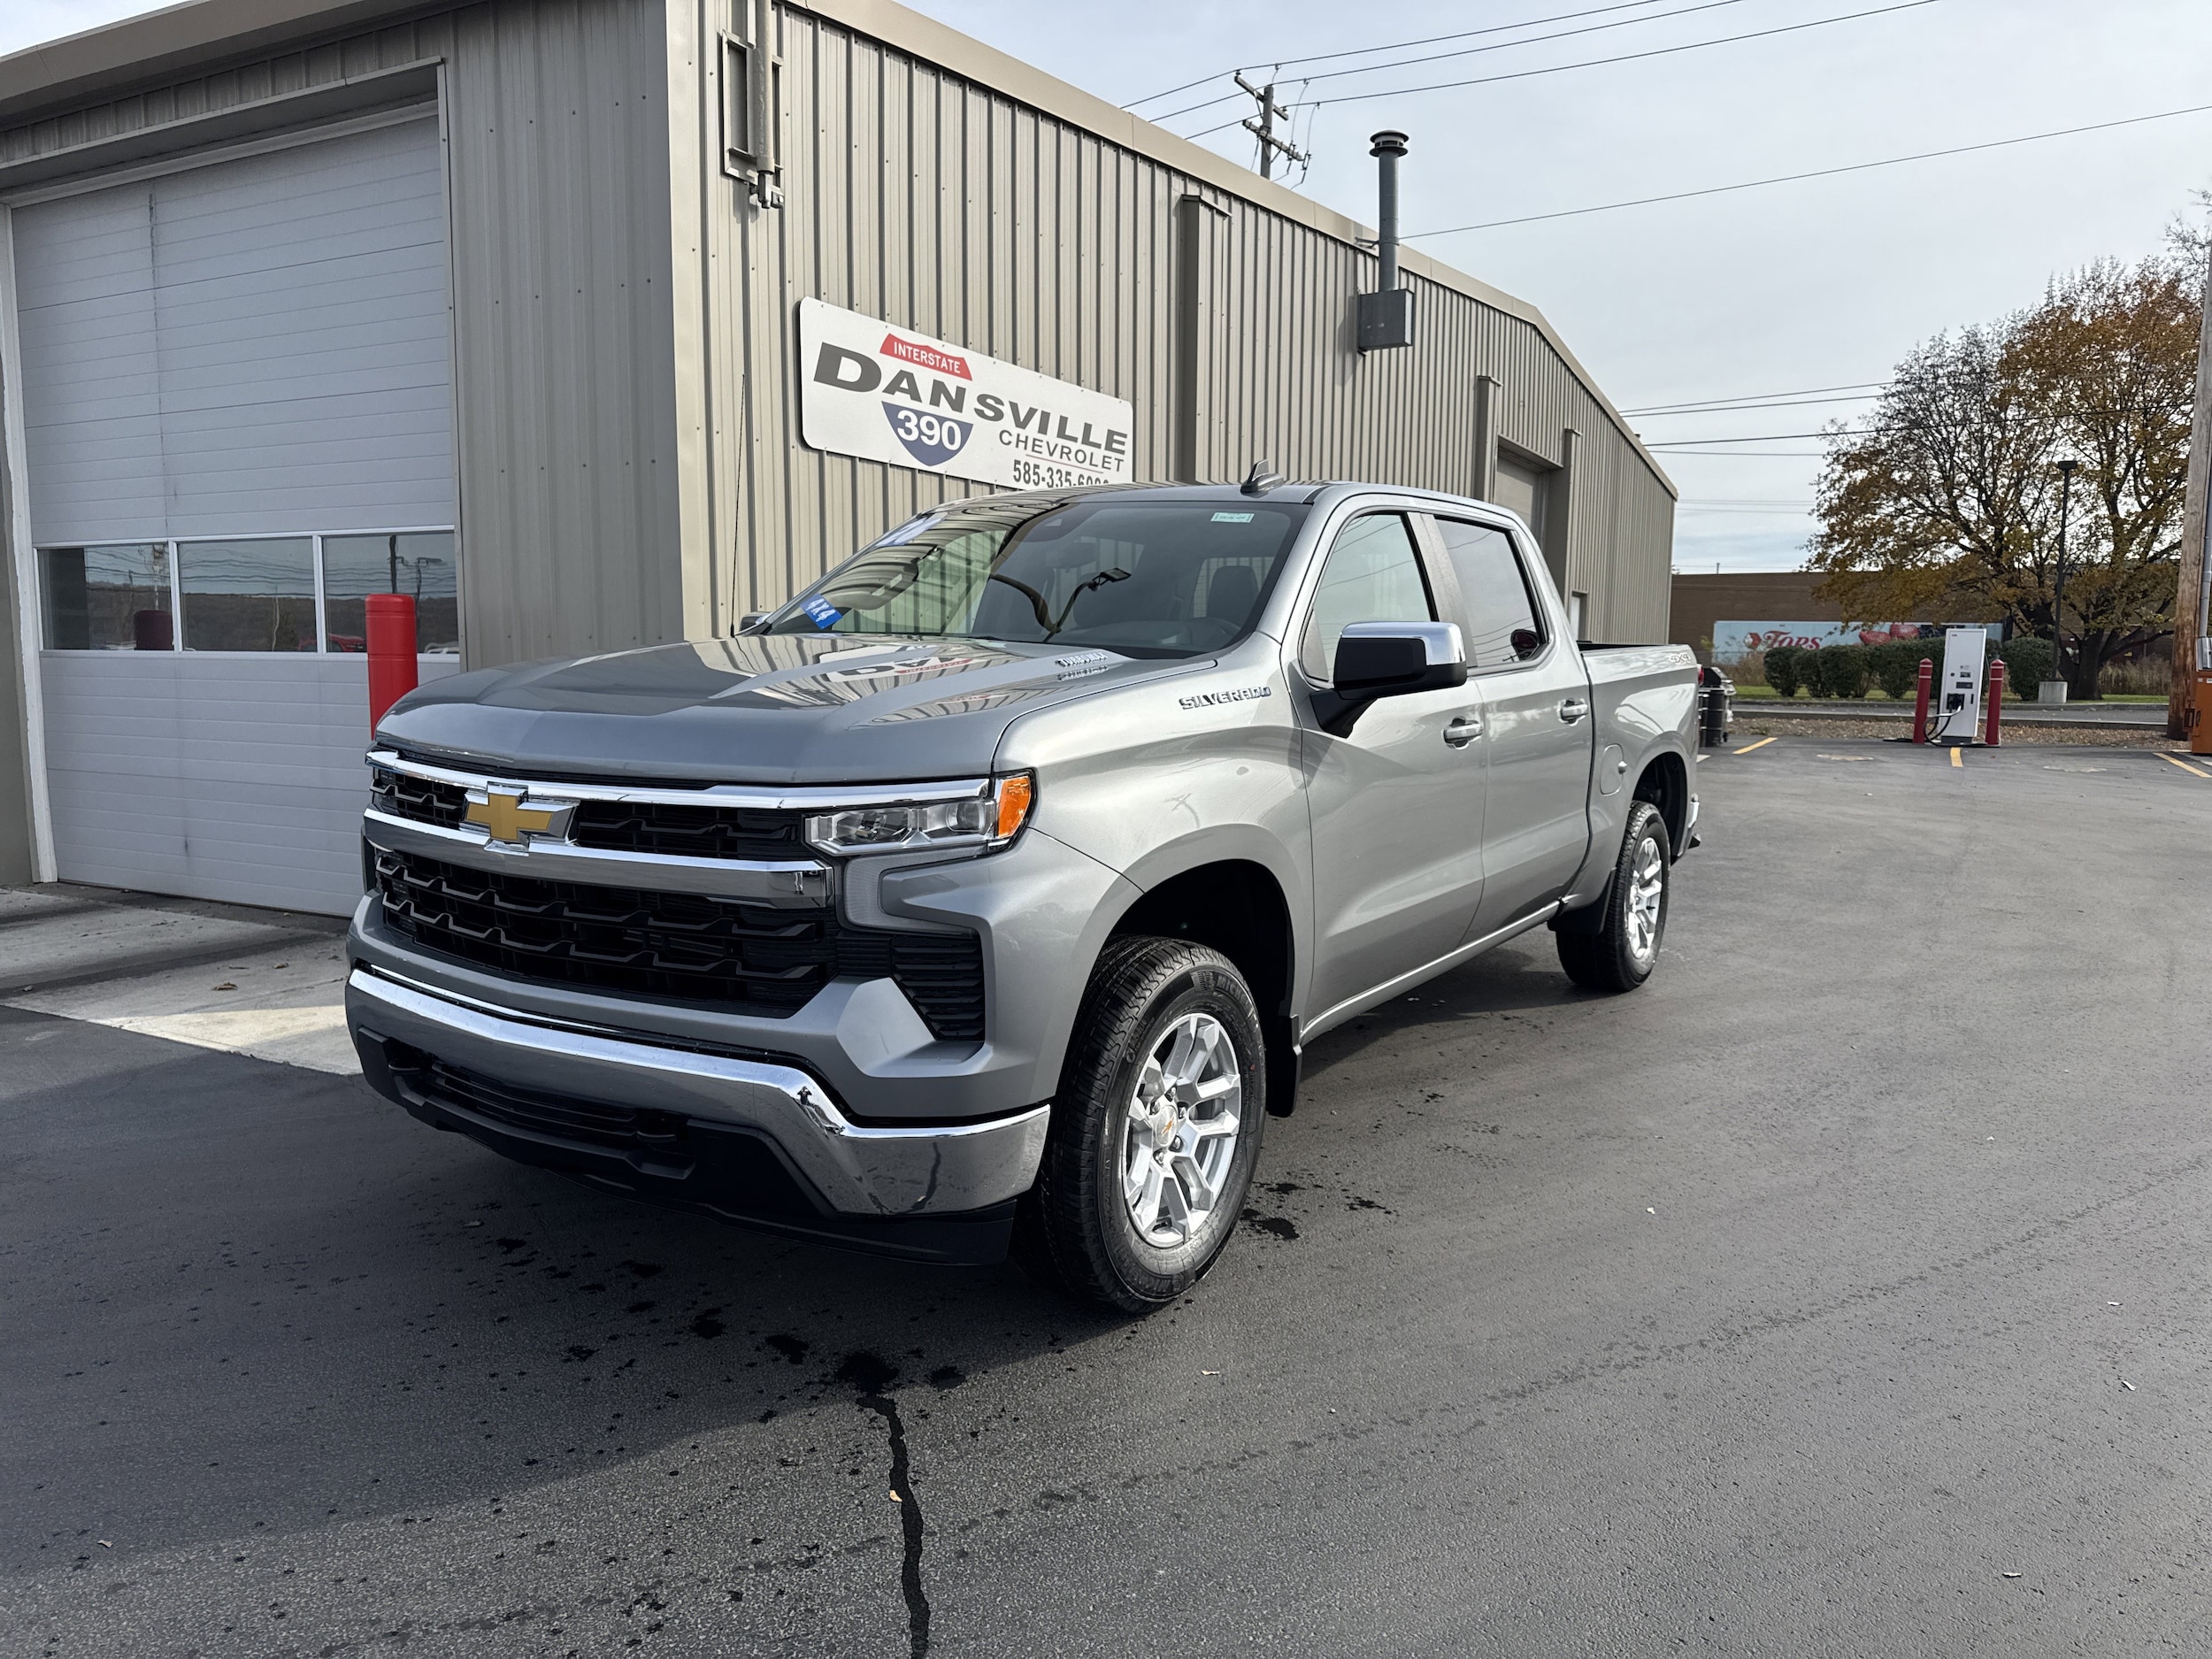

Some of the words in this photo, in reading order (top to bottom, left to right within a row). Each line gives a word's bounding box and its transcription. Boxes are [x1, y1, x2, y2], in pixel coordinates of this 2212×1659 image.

[894, 342, 961, 373] INTERSTATE
[813, 342, 1128, 456] DANSVILLE
[896, 410, 963, 452] 390
[999, 429, 1125, 472] CHEVROLET
[1055, 651, 1109, 667] TURBOMAX
[1179, 687, 1272, 710] SILVERADO
